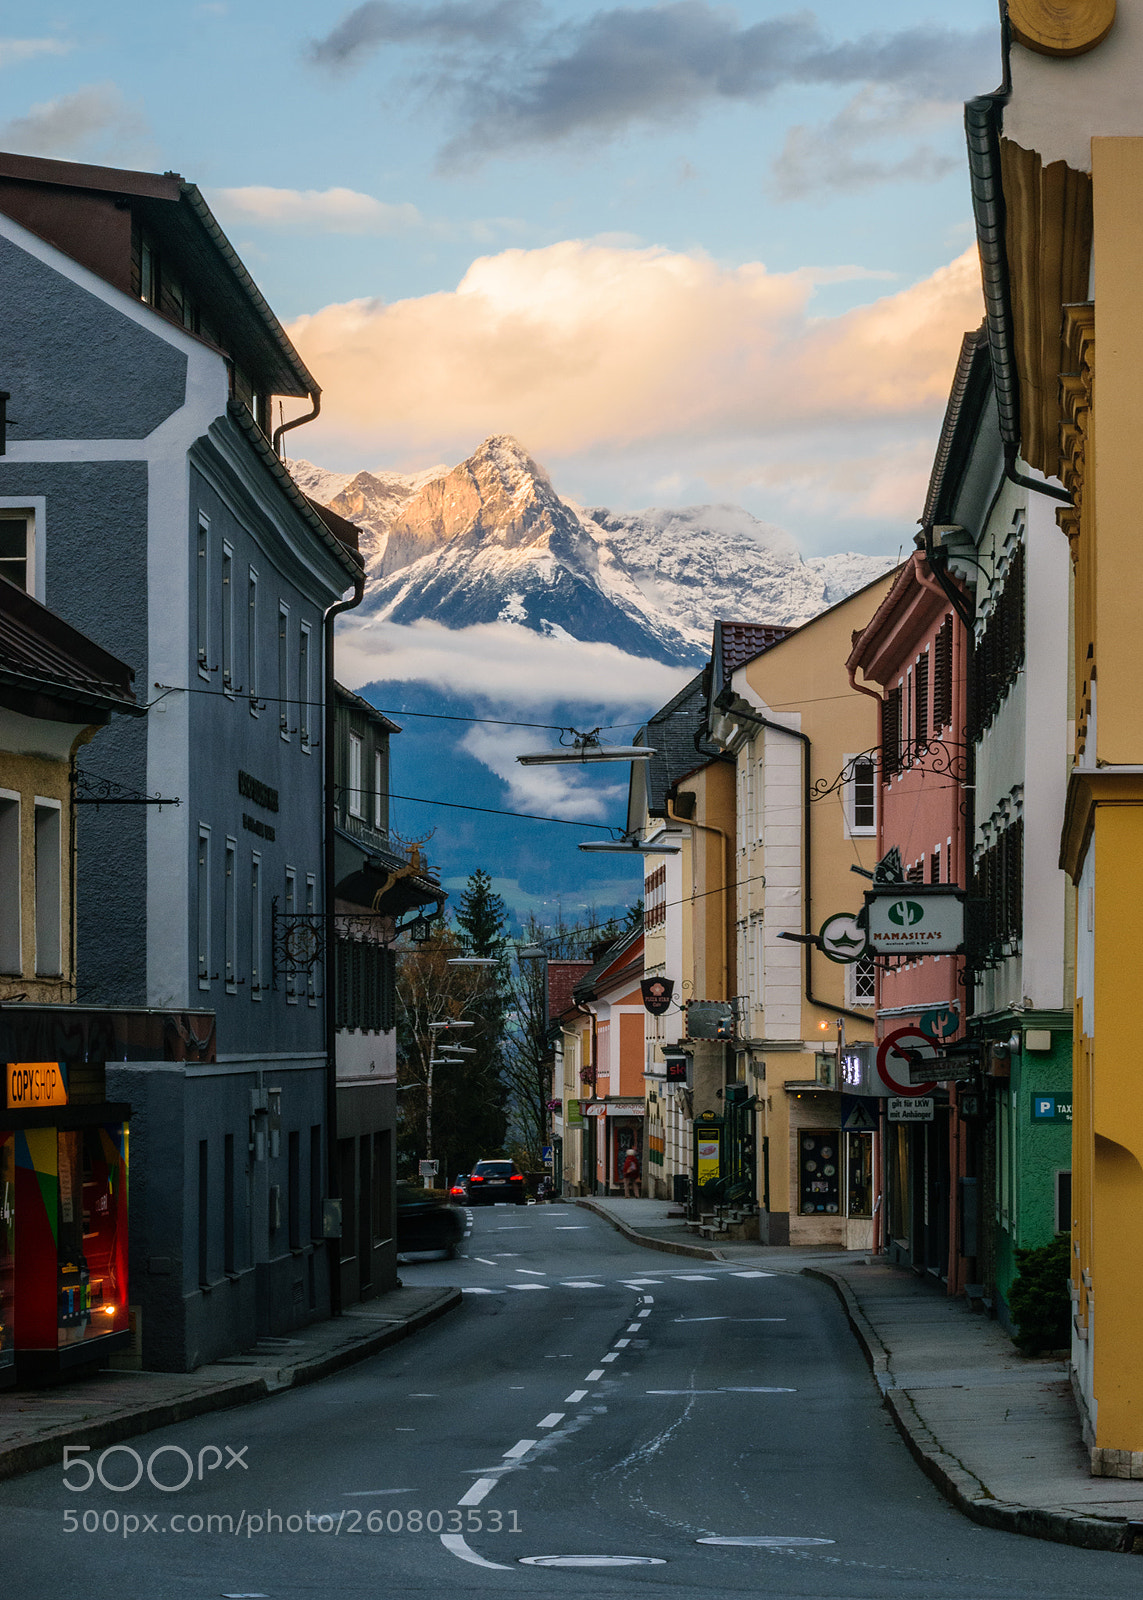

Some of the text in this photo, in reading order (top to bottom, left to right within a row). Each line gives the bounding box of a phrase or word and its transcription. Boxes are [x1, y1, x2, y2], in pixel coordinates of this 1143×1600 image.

[873, 931, 942, 941] MAMASITA'S
[892, 1098, 930, 1109] gilt für LKW
[902, 1110, 932, 1120] Anhänger
